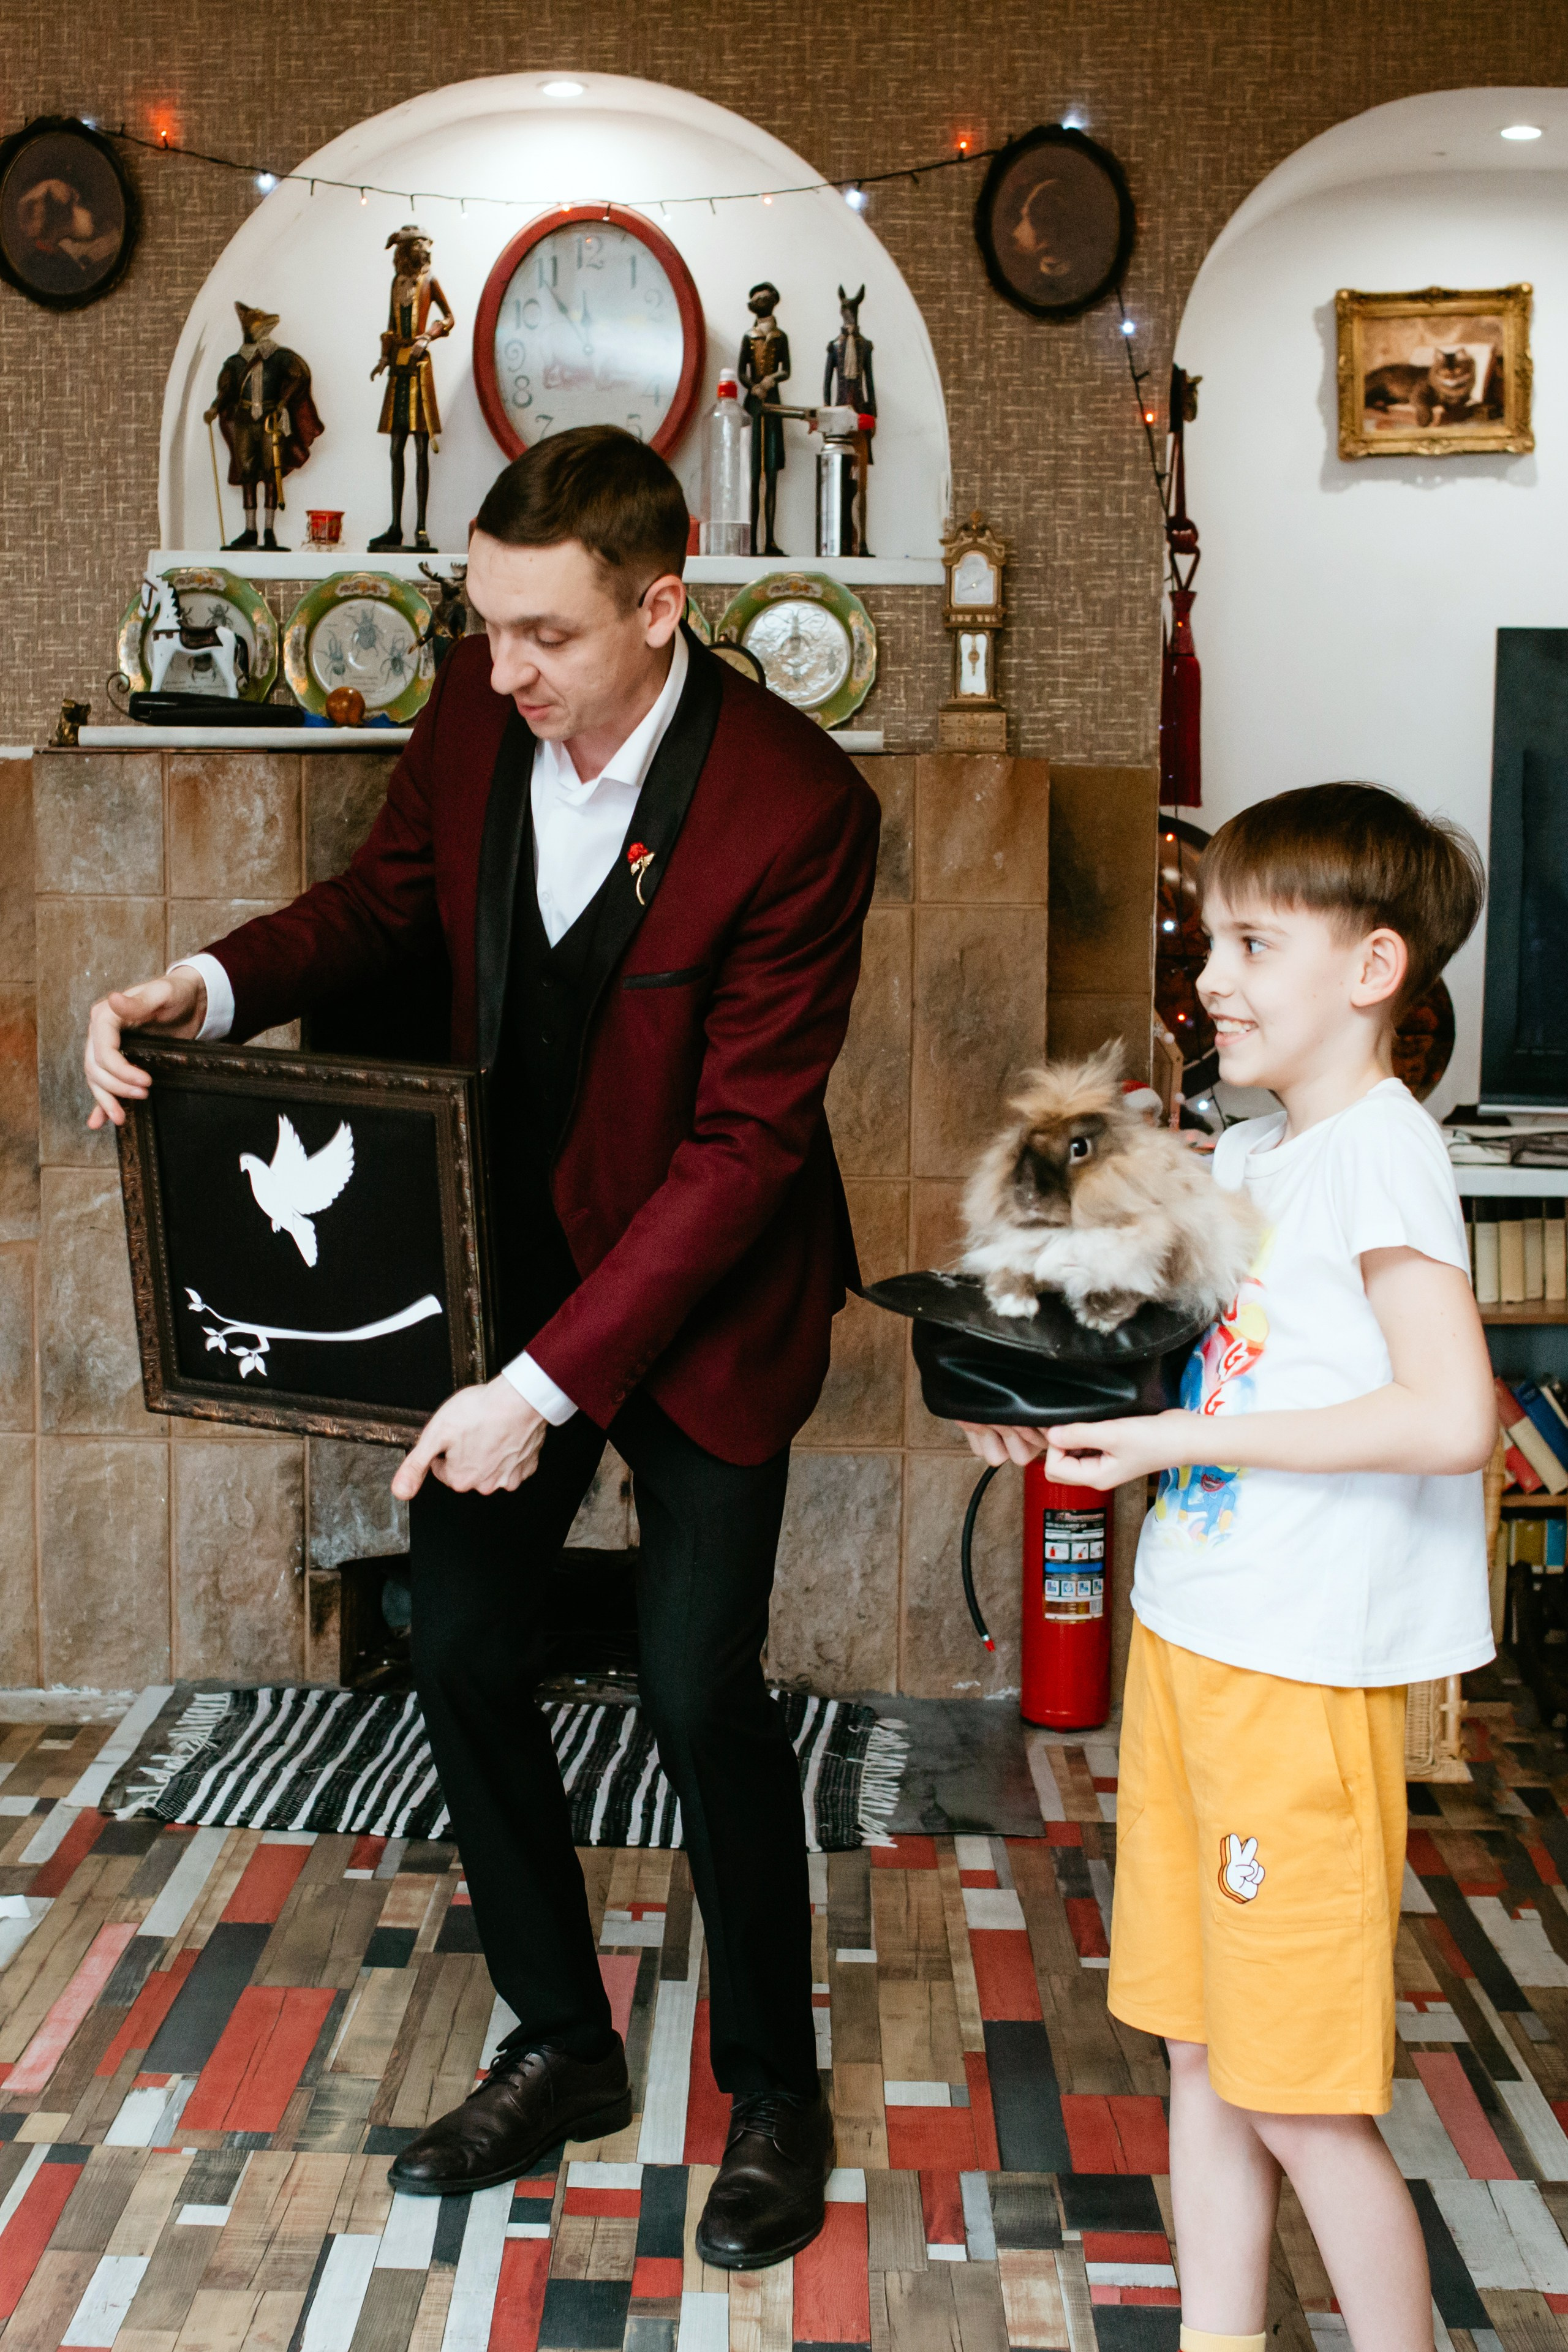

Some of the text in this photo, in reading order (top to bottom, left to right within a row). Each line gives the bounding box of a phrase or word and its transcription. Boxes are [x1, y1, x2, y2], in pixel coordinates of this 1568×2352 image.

[575, 234, 605, 270] 12
[535, 255, 558, 288] 11
[628, 254, 638, 289] 1
[514, 298, 541, 330] 10
[504, 339, 526, 373] 9
[511, 374, 533, 409] 8
[535, 413, 554, 440] 7
